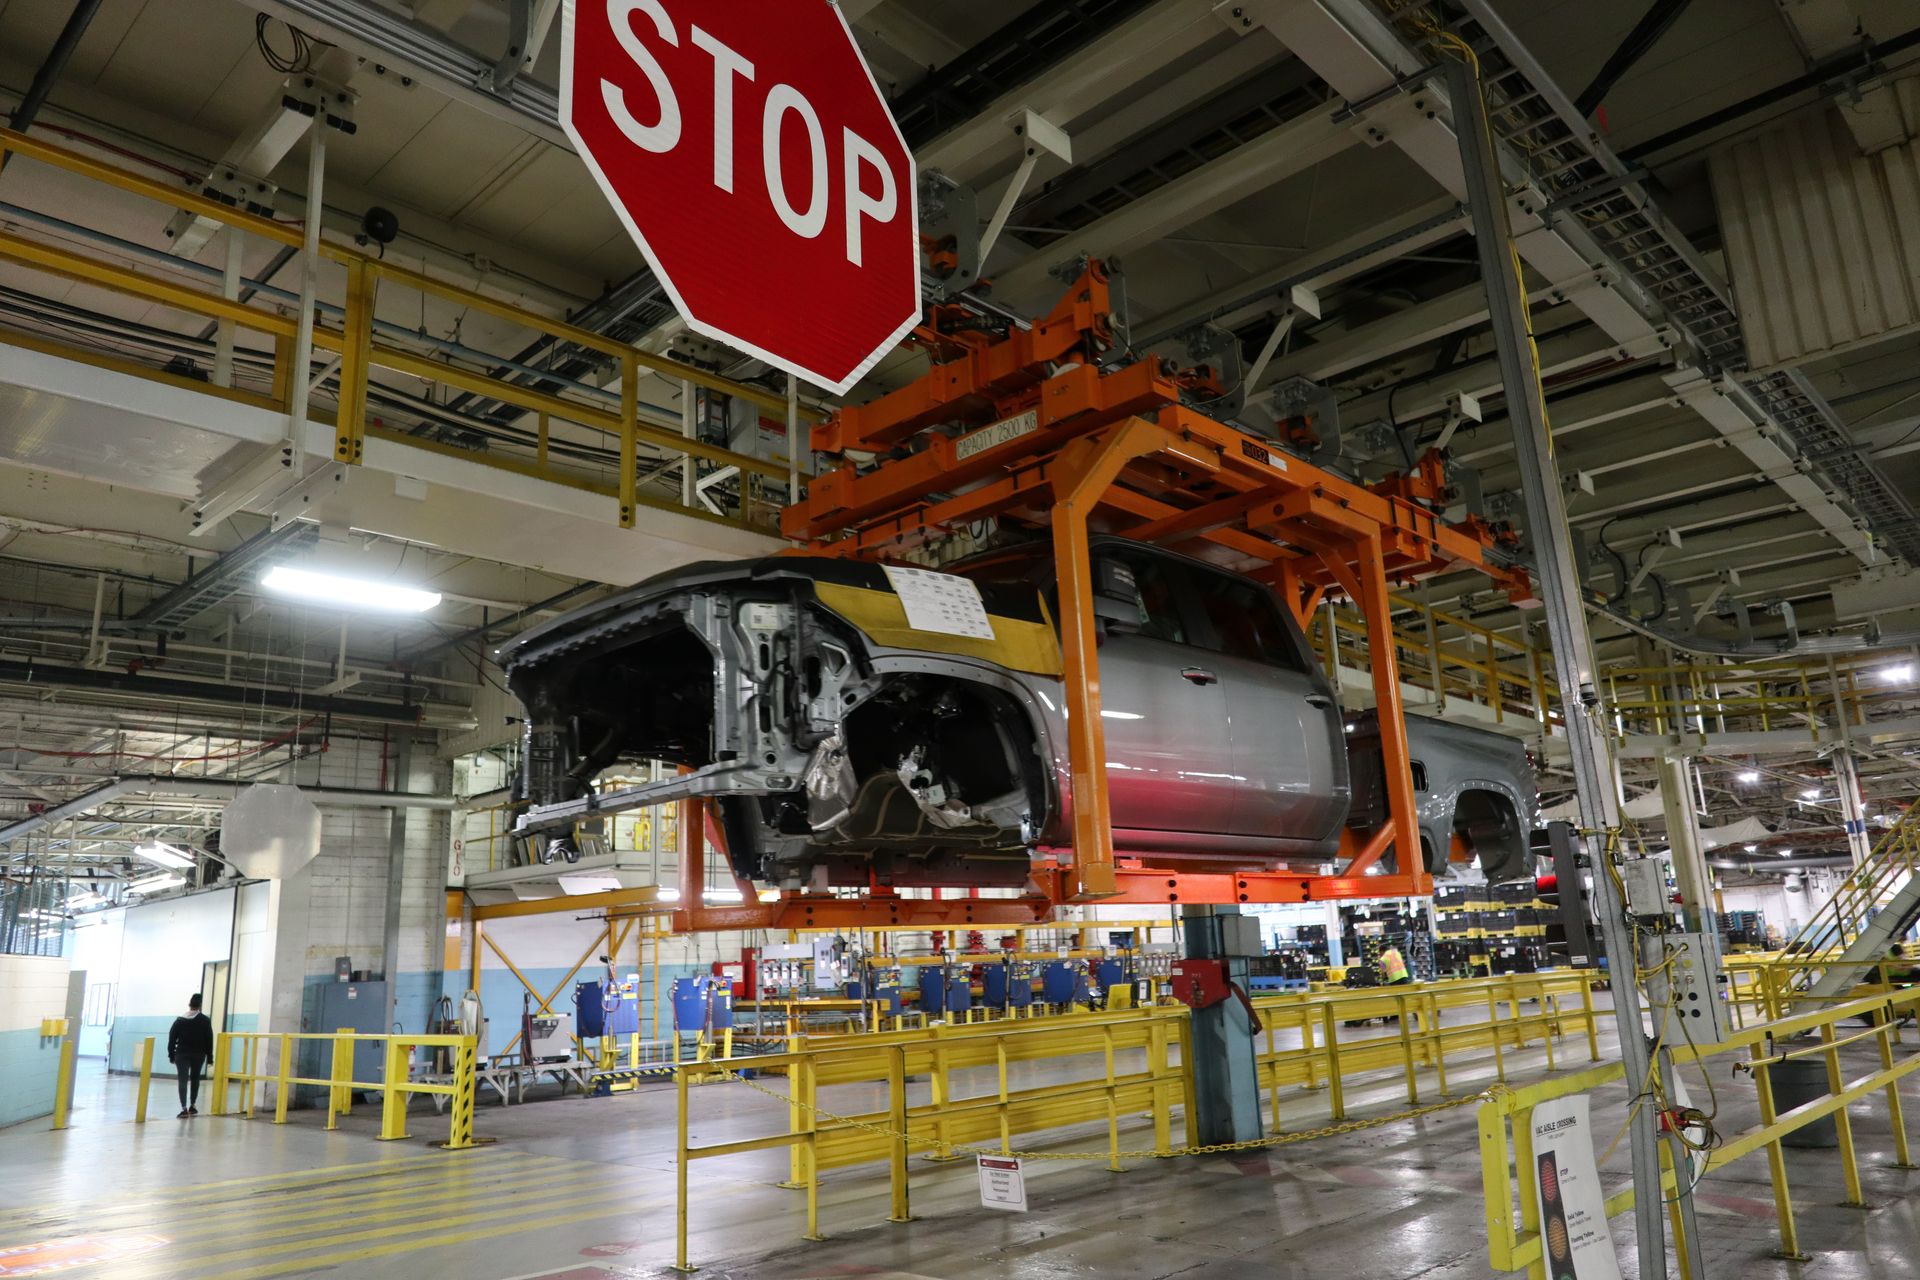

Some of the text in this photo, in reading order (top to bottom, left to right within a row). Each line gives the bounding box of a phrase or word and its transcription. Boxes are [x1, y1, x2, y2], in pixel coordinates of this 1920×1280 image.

[600, 0, 897, 268] STOP
[957, 411, 1036, 459] CAPACITY 2500 KG
[1543, 1122, 1556, 1132] AISLE
